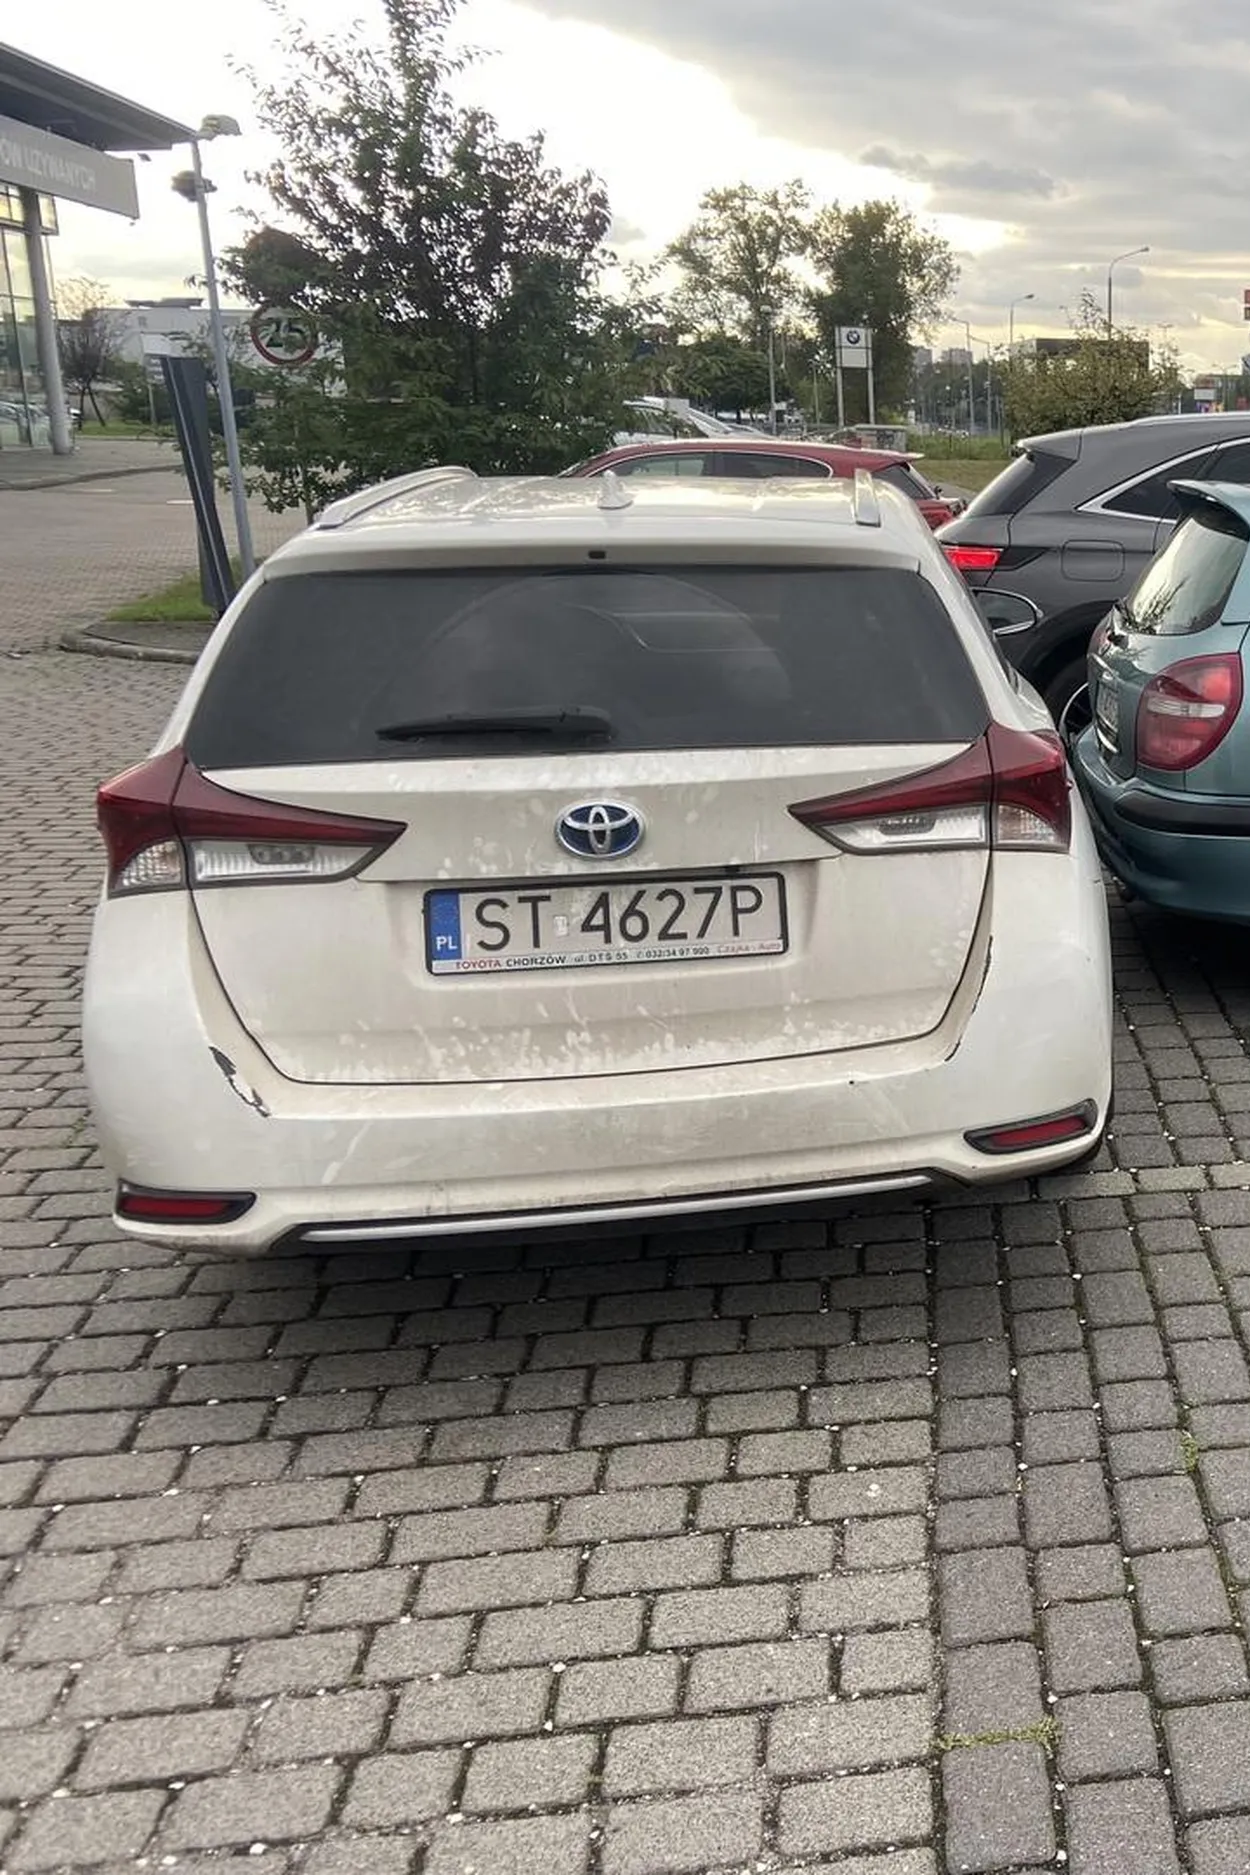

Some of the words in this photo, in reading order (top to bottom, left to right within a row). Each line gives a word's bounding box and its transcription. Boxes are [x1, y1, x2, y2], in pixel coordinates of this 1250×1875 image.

[475, 894, 552, 951] ST
[580, 884, 764, 944] 4627P
[436, 935, 458, 951] PL
[456, 957, 501, 970] TOYOTA
[506, 954, 567, 968] CHORZÓW
